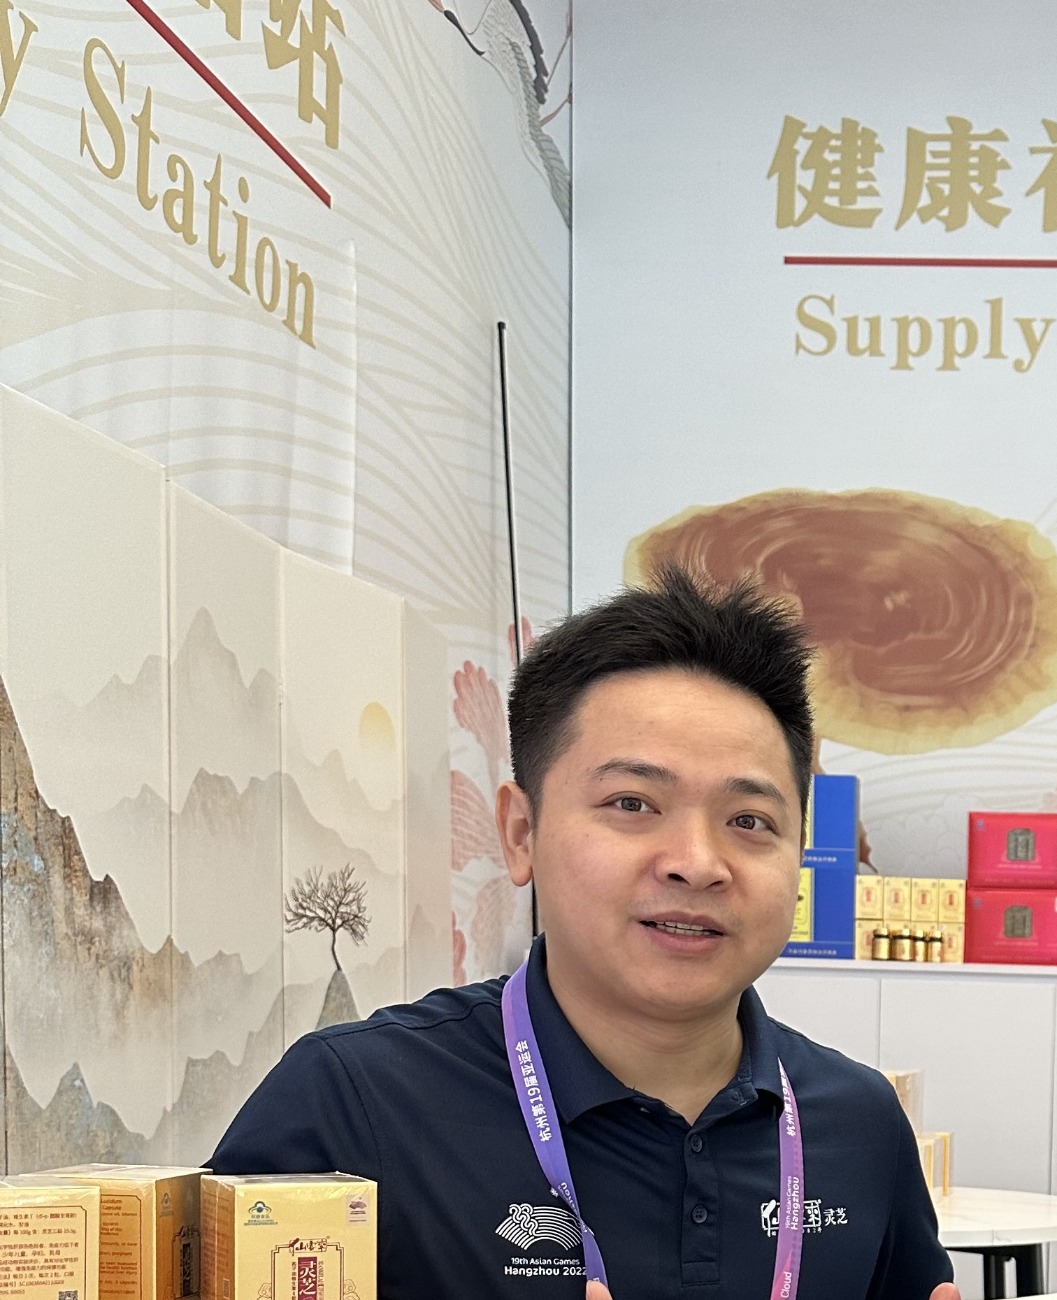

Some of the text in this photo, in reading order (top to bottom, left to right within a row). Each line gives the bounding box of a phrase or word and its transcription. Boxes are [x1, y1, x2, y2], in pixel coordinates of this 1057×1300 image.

[80, 38, 316, 350] Station
[795, 294, 1057, 373] Supply
[515, 1040, 552, 1142] 杭州第19届亚运会
[790, 1177, 800, 1231] Hangzhou
[823, 1207, 848, 1227] 灵芝
[504, 1266, 560, 1277] Hangzhou
[511, 1257, 528, 1265] 19th
[780, 1271, 792, 1298] Cloud
